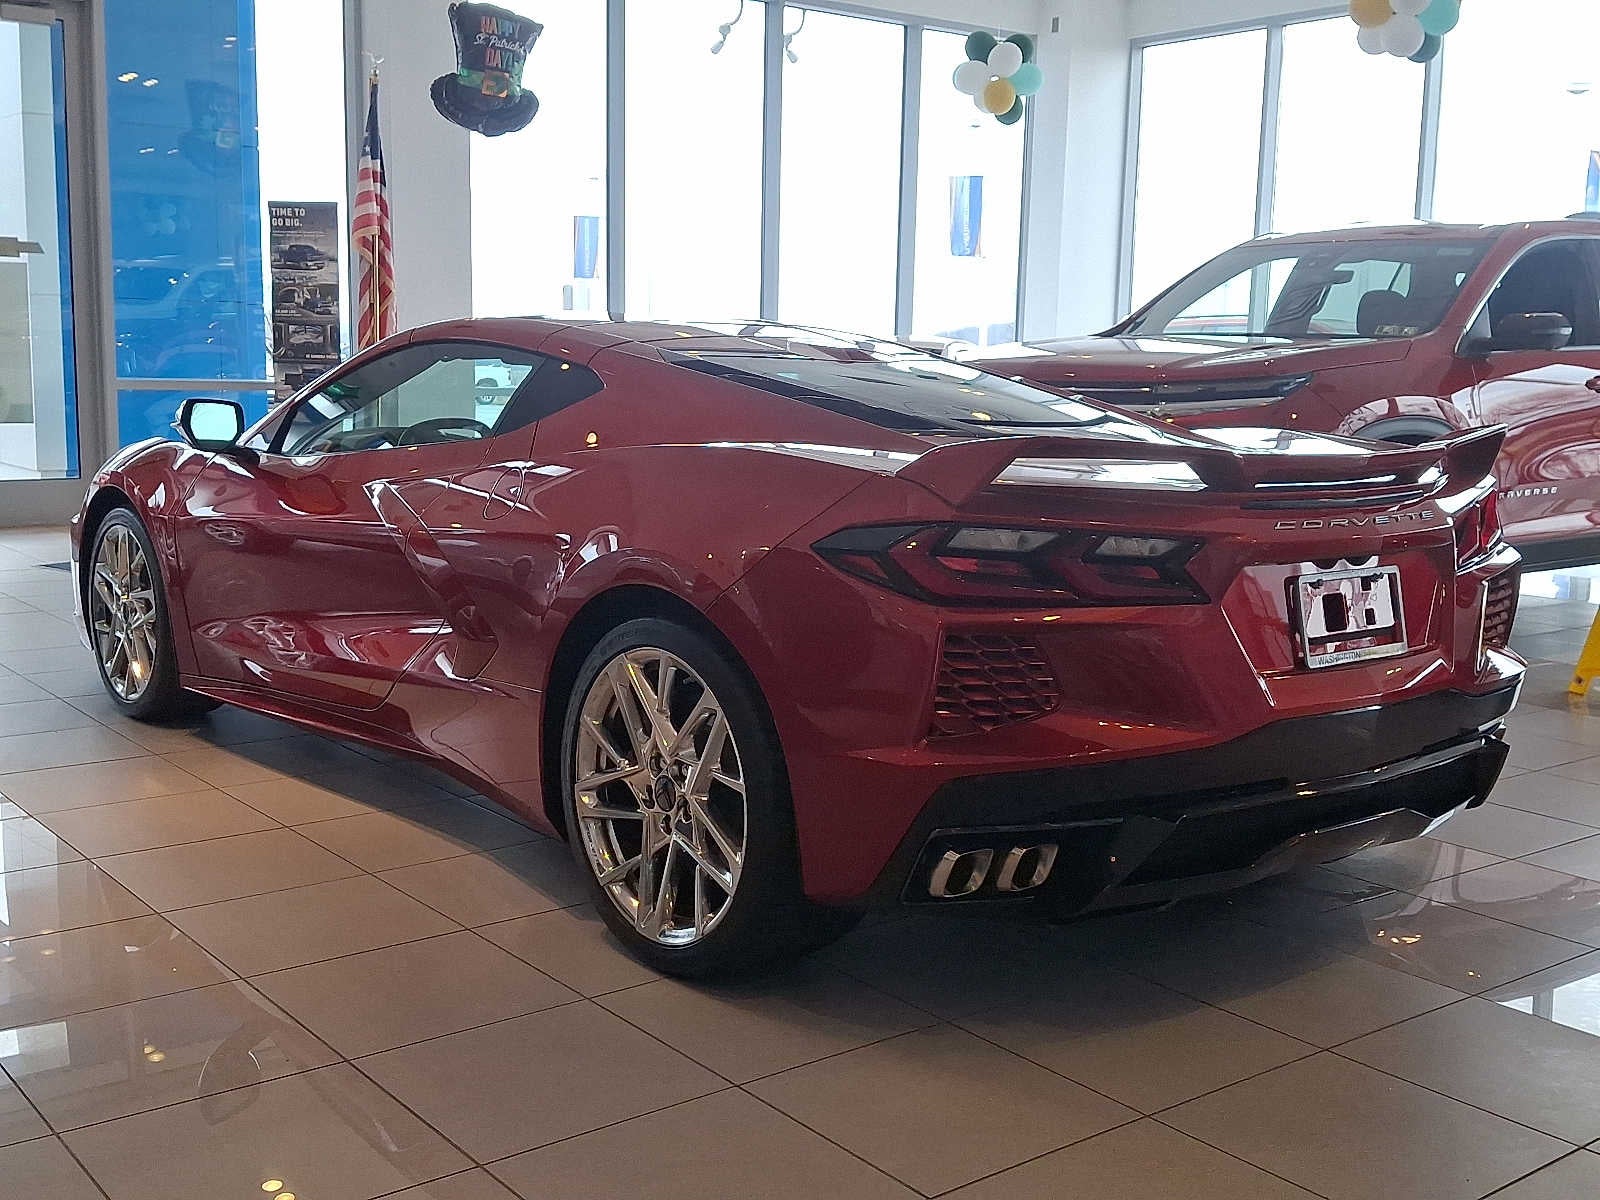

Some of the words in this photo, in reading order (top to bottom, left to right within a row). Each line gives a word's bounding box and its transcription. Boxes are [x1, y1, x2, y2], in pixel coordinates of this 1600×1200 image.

[271, 207, 292, 216] TIME
[294, 207, 305, 216] TO
[271, 217, 283, 226] GO
[284, 217, 302, 227] BIG.
[1498, 486, 1558, 499] RAVERSE
[1274, 510, 1435, 531] CORVETTE
